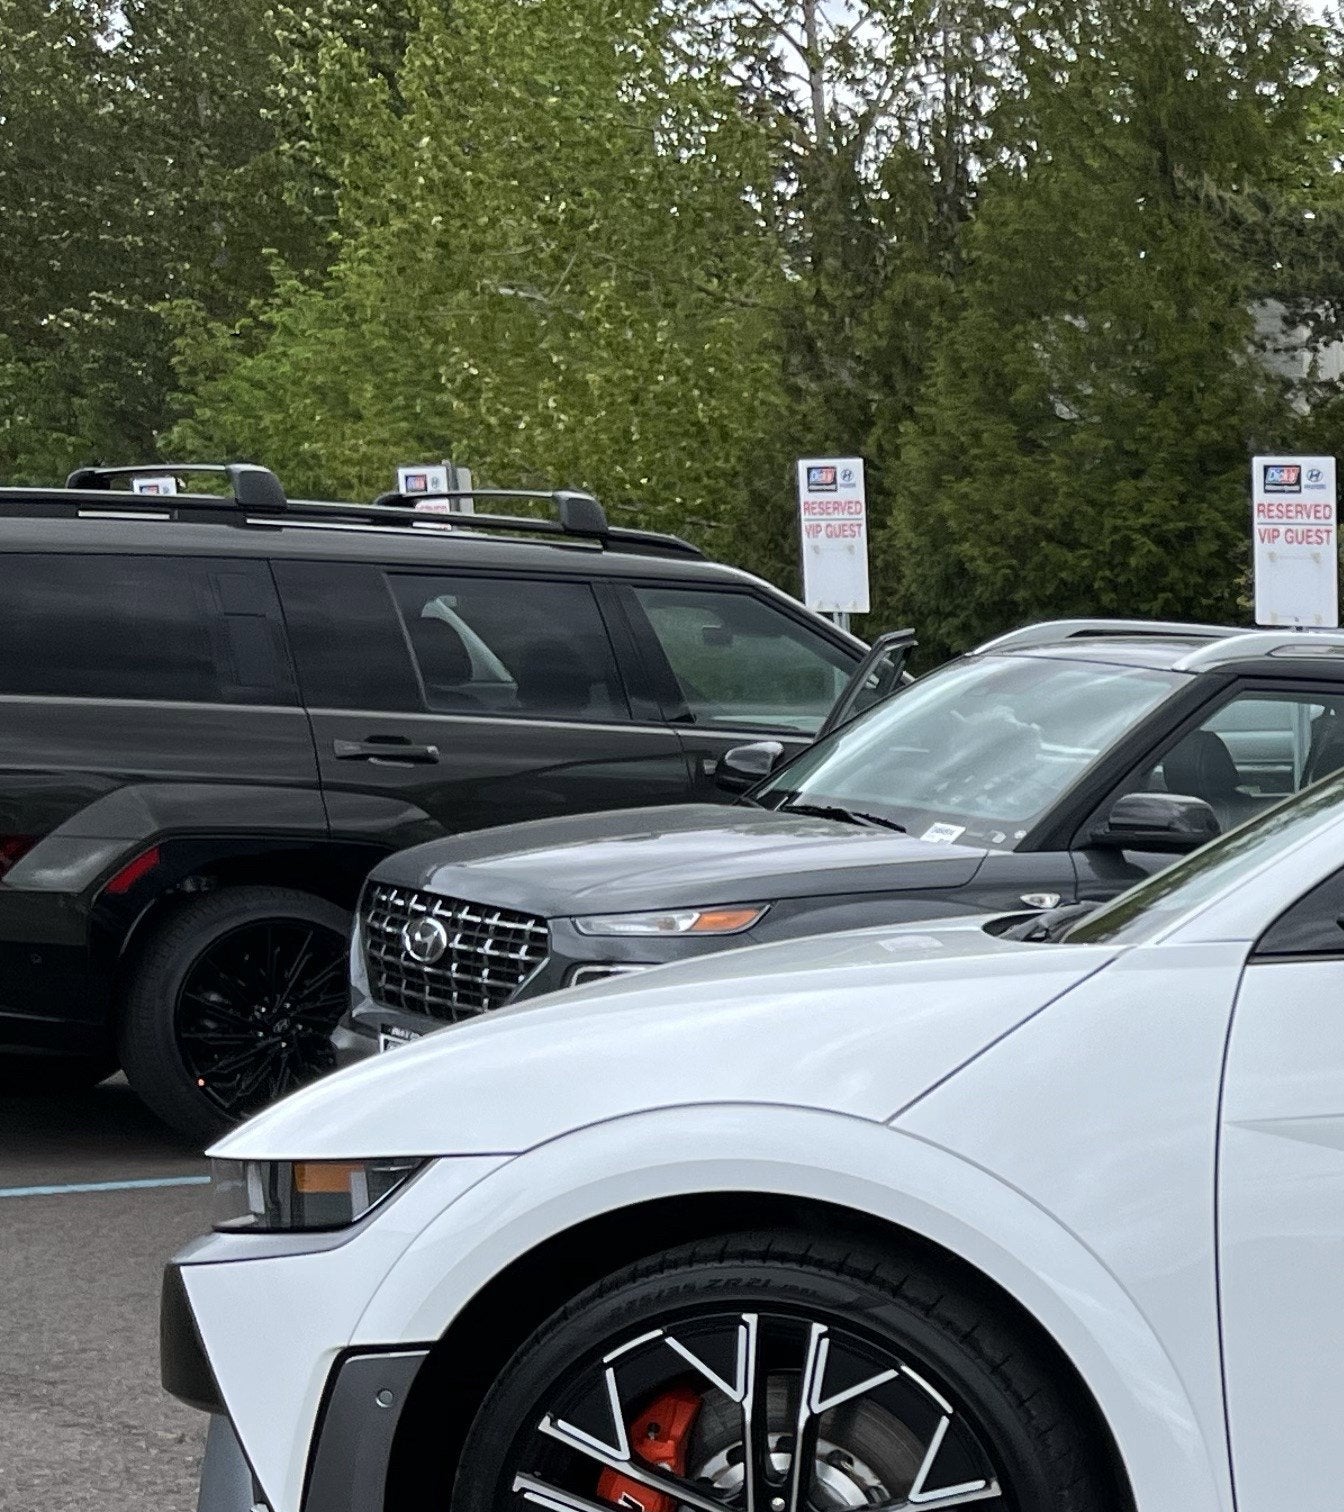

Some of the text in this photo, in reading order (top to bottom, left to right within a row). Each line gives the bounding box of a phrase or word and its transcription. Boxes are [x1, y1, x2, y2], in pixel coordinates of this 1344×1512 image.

[803, 501, 862, 516] RESERVED
[1256, 503, 1333, 520] RESERVED
[804, 523, 862, 539] VIP GUEST
[1258, 528, 1332, 545] VIP GUEST
